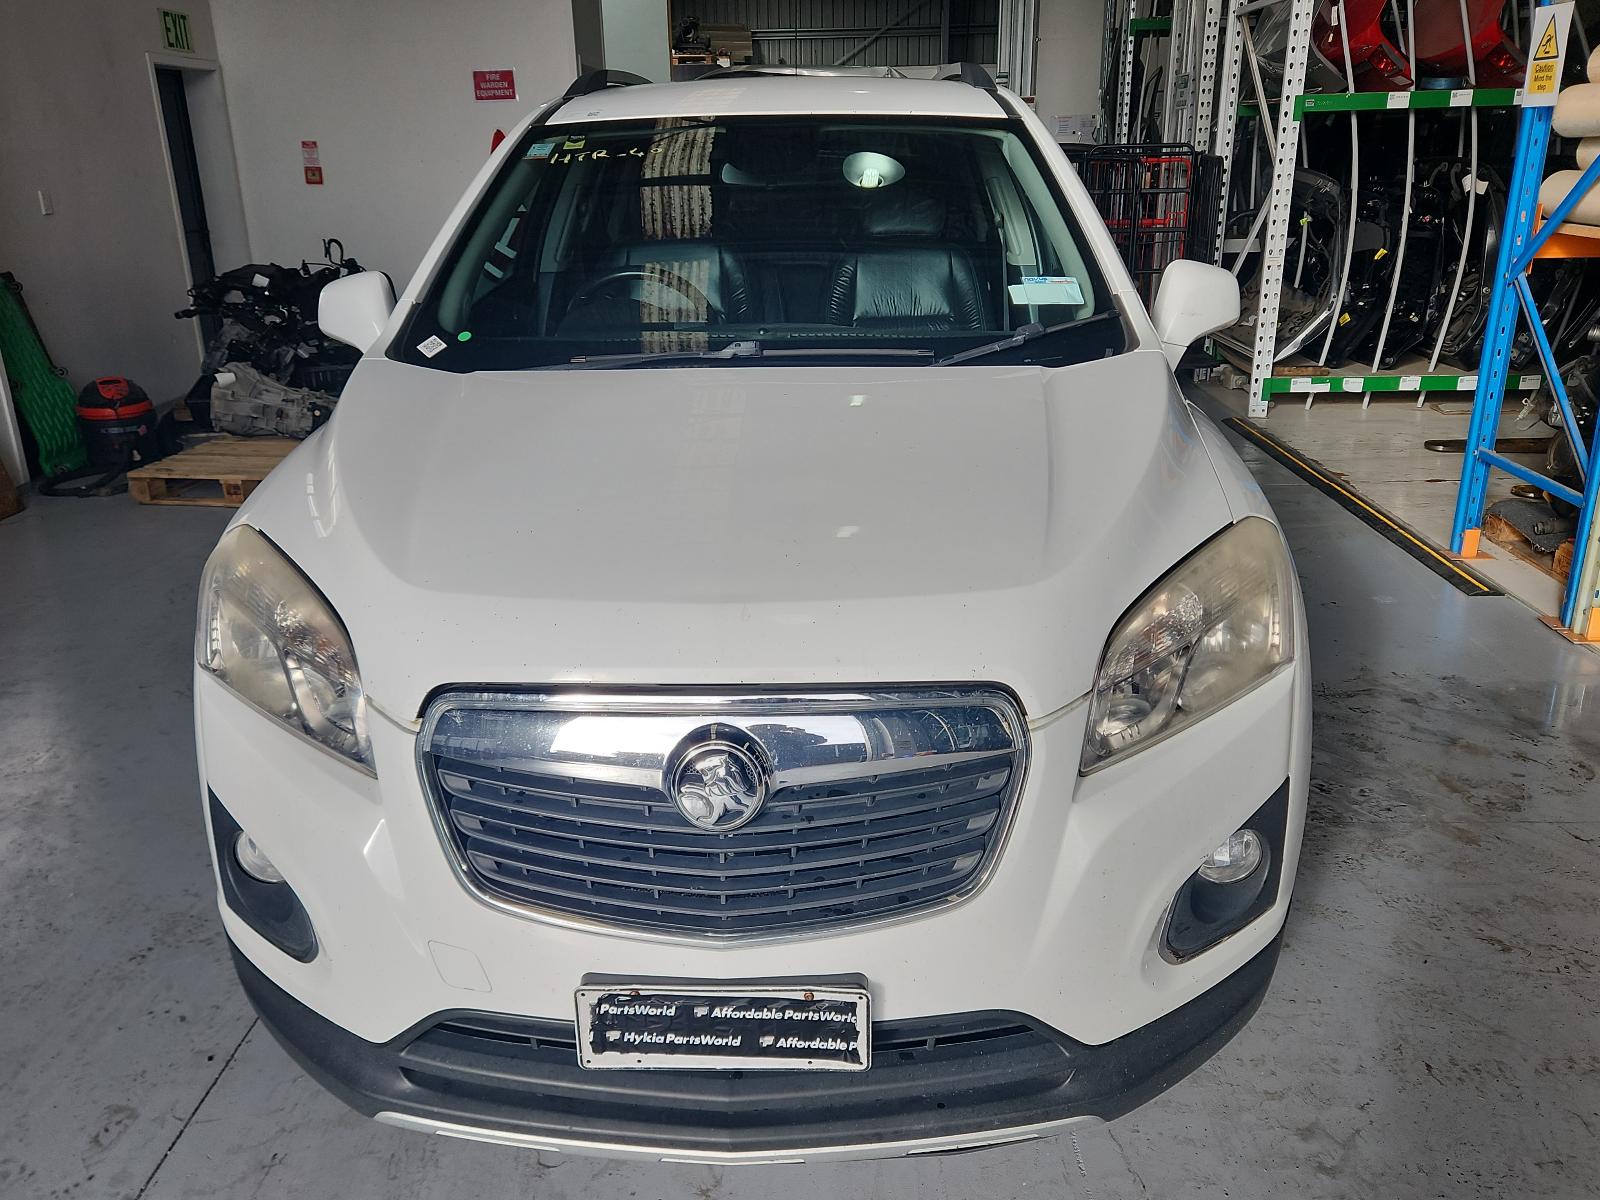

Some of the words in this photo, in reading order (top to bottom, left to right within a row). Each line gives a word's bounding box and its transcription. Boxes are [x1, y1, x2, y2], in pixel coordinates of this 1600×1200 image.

[163, 11, 190, 50] EXIT
[486, 73, 501, 81] FIRE
[1534, 74, 1545, 82] Mind
[480, 81, 508, 89] WARDEN
[1536, 84, 1546, 93] step
[476, 89, 513, 97] EQUIPMENT
[600, 1004, 676, 1017] PartsWorld
[710, 1006, 782, 1020] Affordable
[623, 1032, 665, 1045] Hykia
[665, 1033, 742, 1047] PartsWorld
[775, 1037, 848, 1051] Affordable
